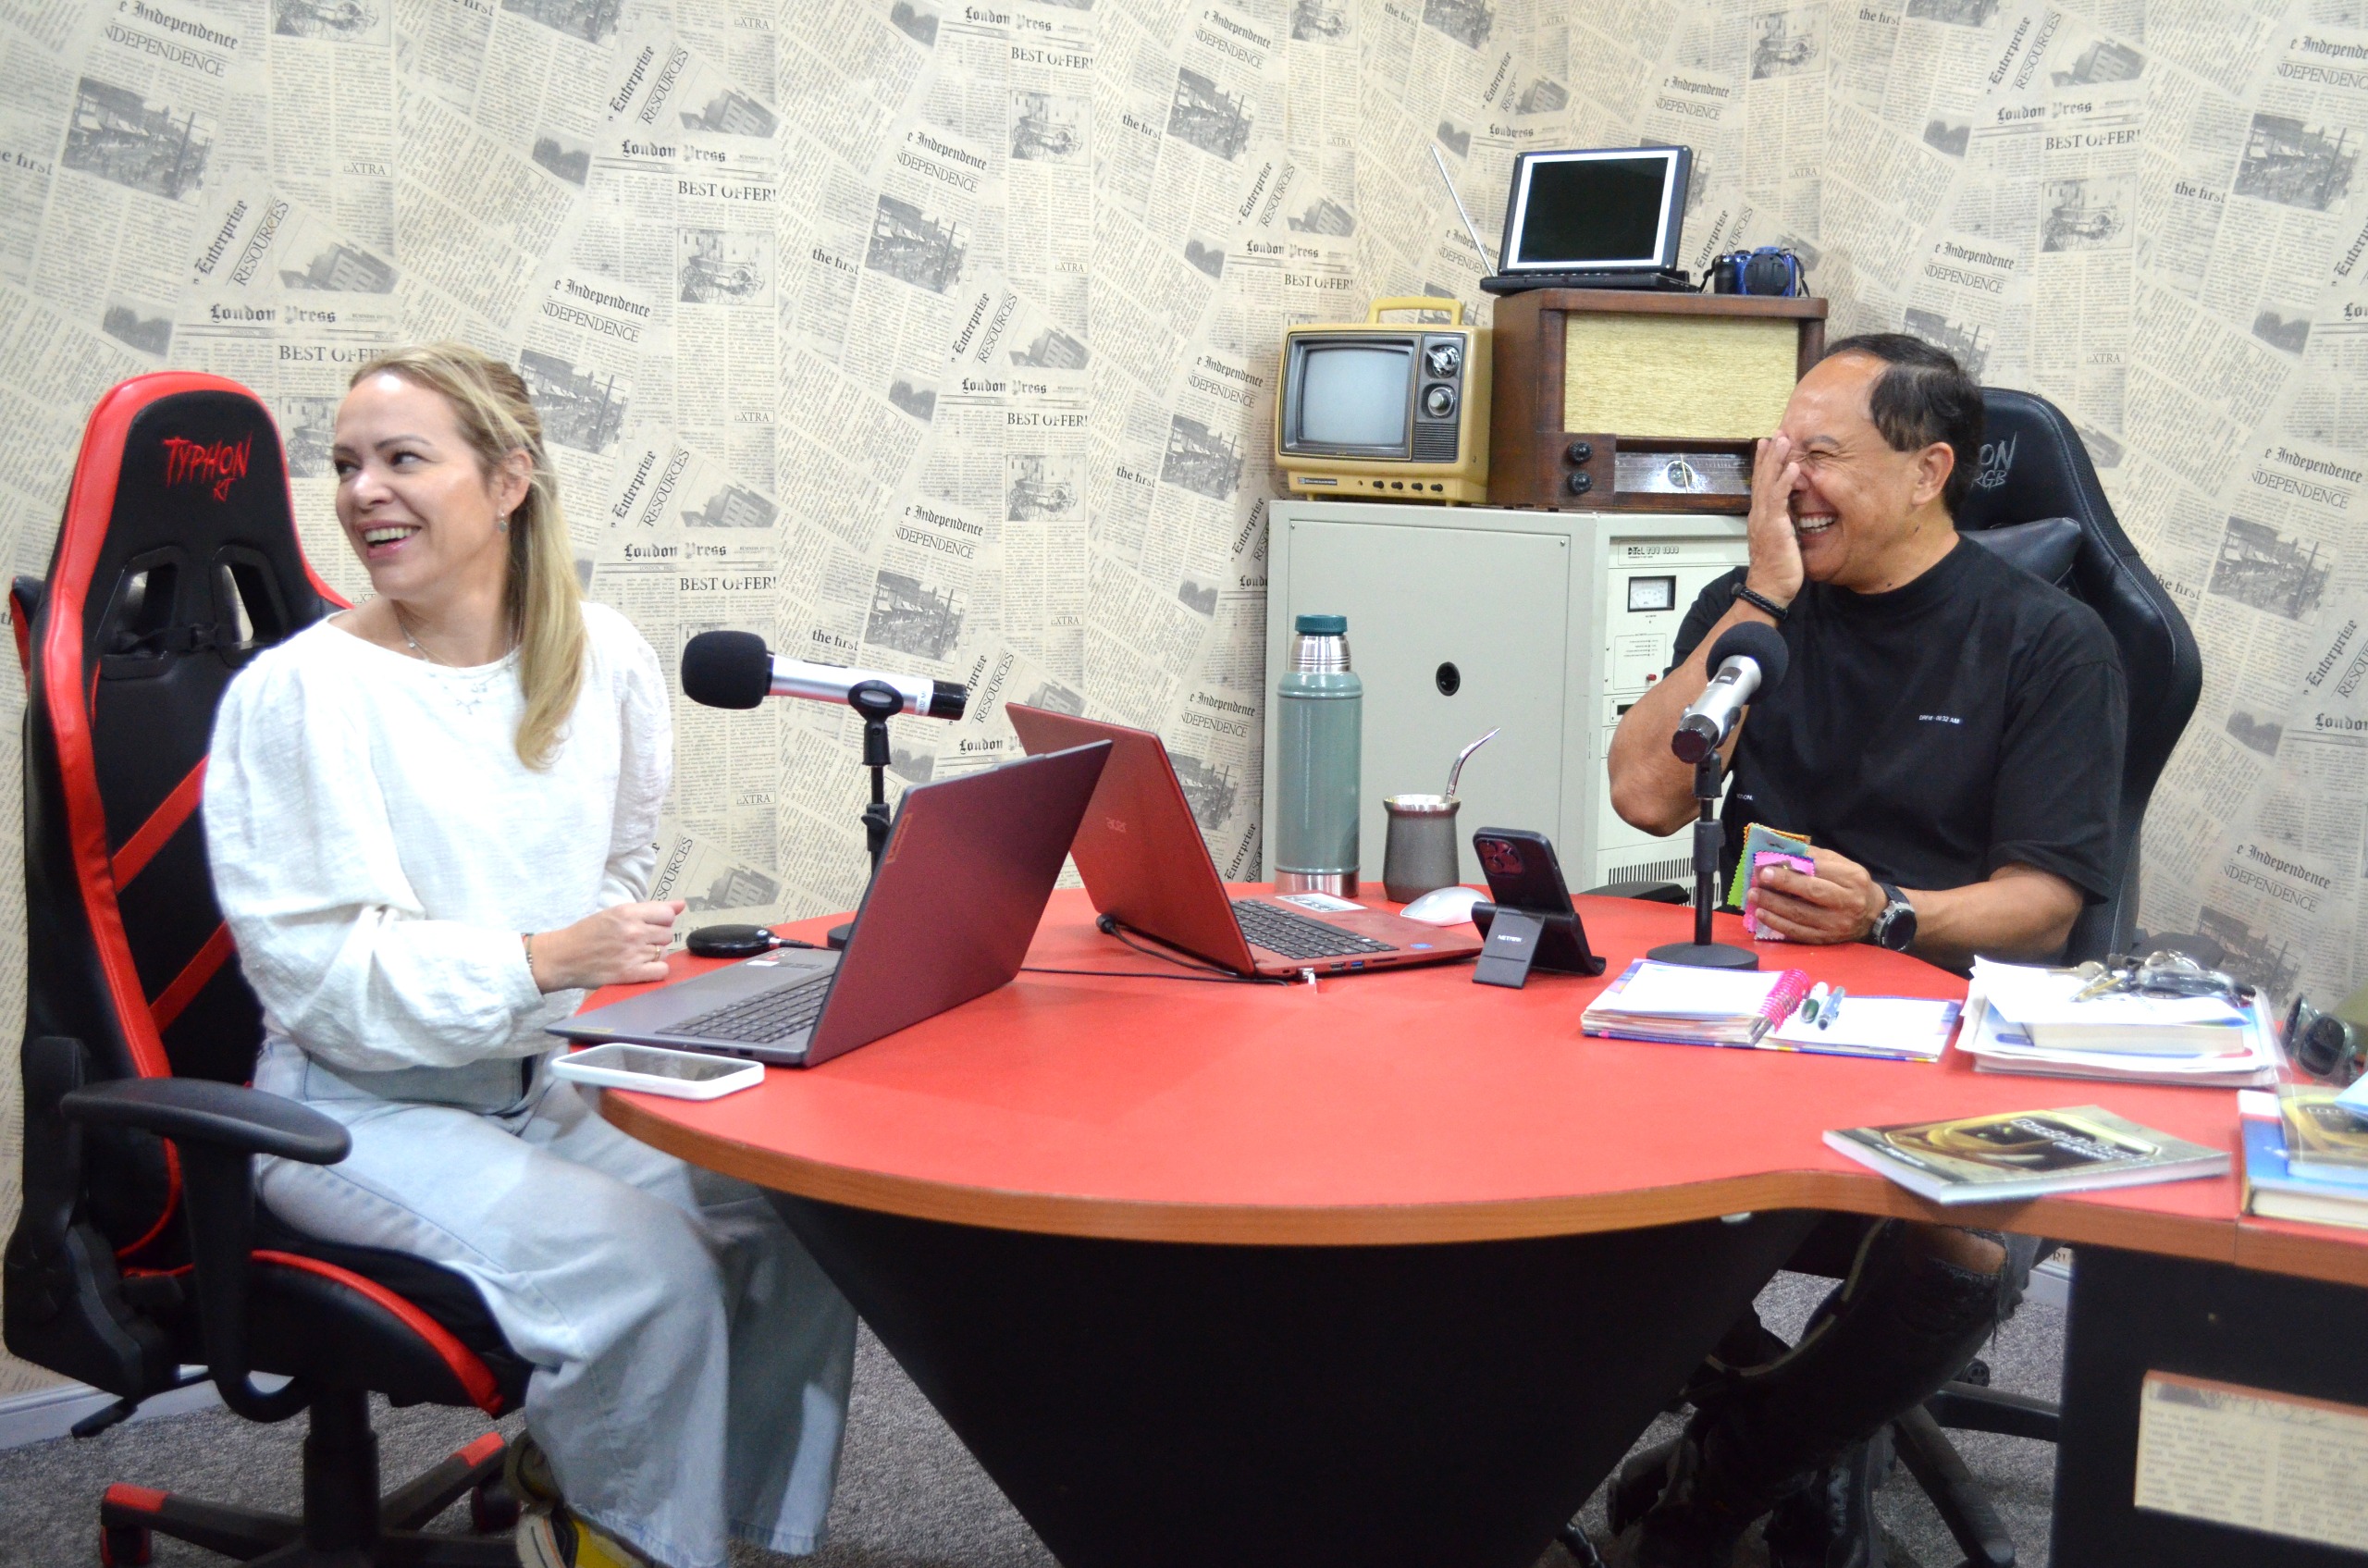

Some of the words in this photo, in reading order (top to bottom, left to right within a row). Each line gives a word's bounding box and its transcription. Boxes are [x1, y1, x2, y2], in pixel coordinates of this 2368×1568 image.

[133, 1, 239, 50] Independence
[964, 6, 1010, 27] London
[1210, 9, 1271, 48] Independence
[1384, 4, 1400, 19] the
[1859, 9, 1875, 22] the
[1011, 46, 1044, 63] BEST
[1989, 17, 2031, 86] Enterprise
[2016, 12, 2062, 91] RESOURCES
[609, 45, 655, 113] Enterprise
[641, 47, 689, 125] RESOURCES
[1483, 51, 1512, 104] Enterprise
[1671, 76, 1731, 99] Independence
[1123, 114, 1140, 130] the
[1997, 104, 2046, 125] London
[622, 139, 676, 158] London
[915, 130, 988, 171] Independence
[2044, 134, 2081, 152] BEST
[678, 180, 718, 197] BEST
[1240, 161, 1272, 220] Enterprise
[1261, 163, 1296, 228] RESOURCES
[2175, 180, 2195, 196] the
[194, 200, 248, 275] Enterprise
[233, 199, 289, 287] RESOURCES
[1695, 210, 1729, 269] Enterprise
[1726, 206, 1754, 254] OURCES
[812, 246, 832, 265] the
[1246, 240, 1285, 255] London
[1943, 241, 2016, 271] Independence
[1284, 273, 1312, 288] BEST
[210, 303, 276, 323] London
[563, 278, 650, 318] Independence
[954, 291, 991, 355] Enterprise
[978, 292, 1018, 364] RESOURCES
[278, 345, 326, 362] BEST
[961, 377, 1007, 394] London
[1203, 355, 1264, 389] Independence
[1006, 412, 1040, 426] BEST
[163, 431, 253, 488] TYPHON
[1116, 465, 1134, 482] the
[2276, 446, 2363, 483] Independence
[614, 451, 657, 519] Enterprise
[643, 449, 690, 527] RESOURCES
[914, 504, 984, 537] Independence
[1232, 498, 1264, 555] Enterprise
[623, 542, 678, 562] London
[679, 577, 719, 591] BEST
[2153, 574, 2173, 589] he
[812, 629, 831, 645] the
[2305, 620, 2357, 686] Enterprise
[975, 652, 1014, 723] RESOURCES
[1197, 691, 1256, 718] Independence
[959, 738, 1003, 755] London
[1225, 823, 1256, 881] Enterprise
[2246, 844, 2331, 889] Independence
[657, 837, 693, 902] SOURCES
